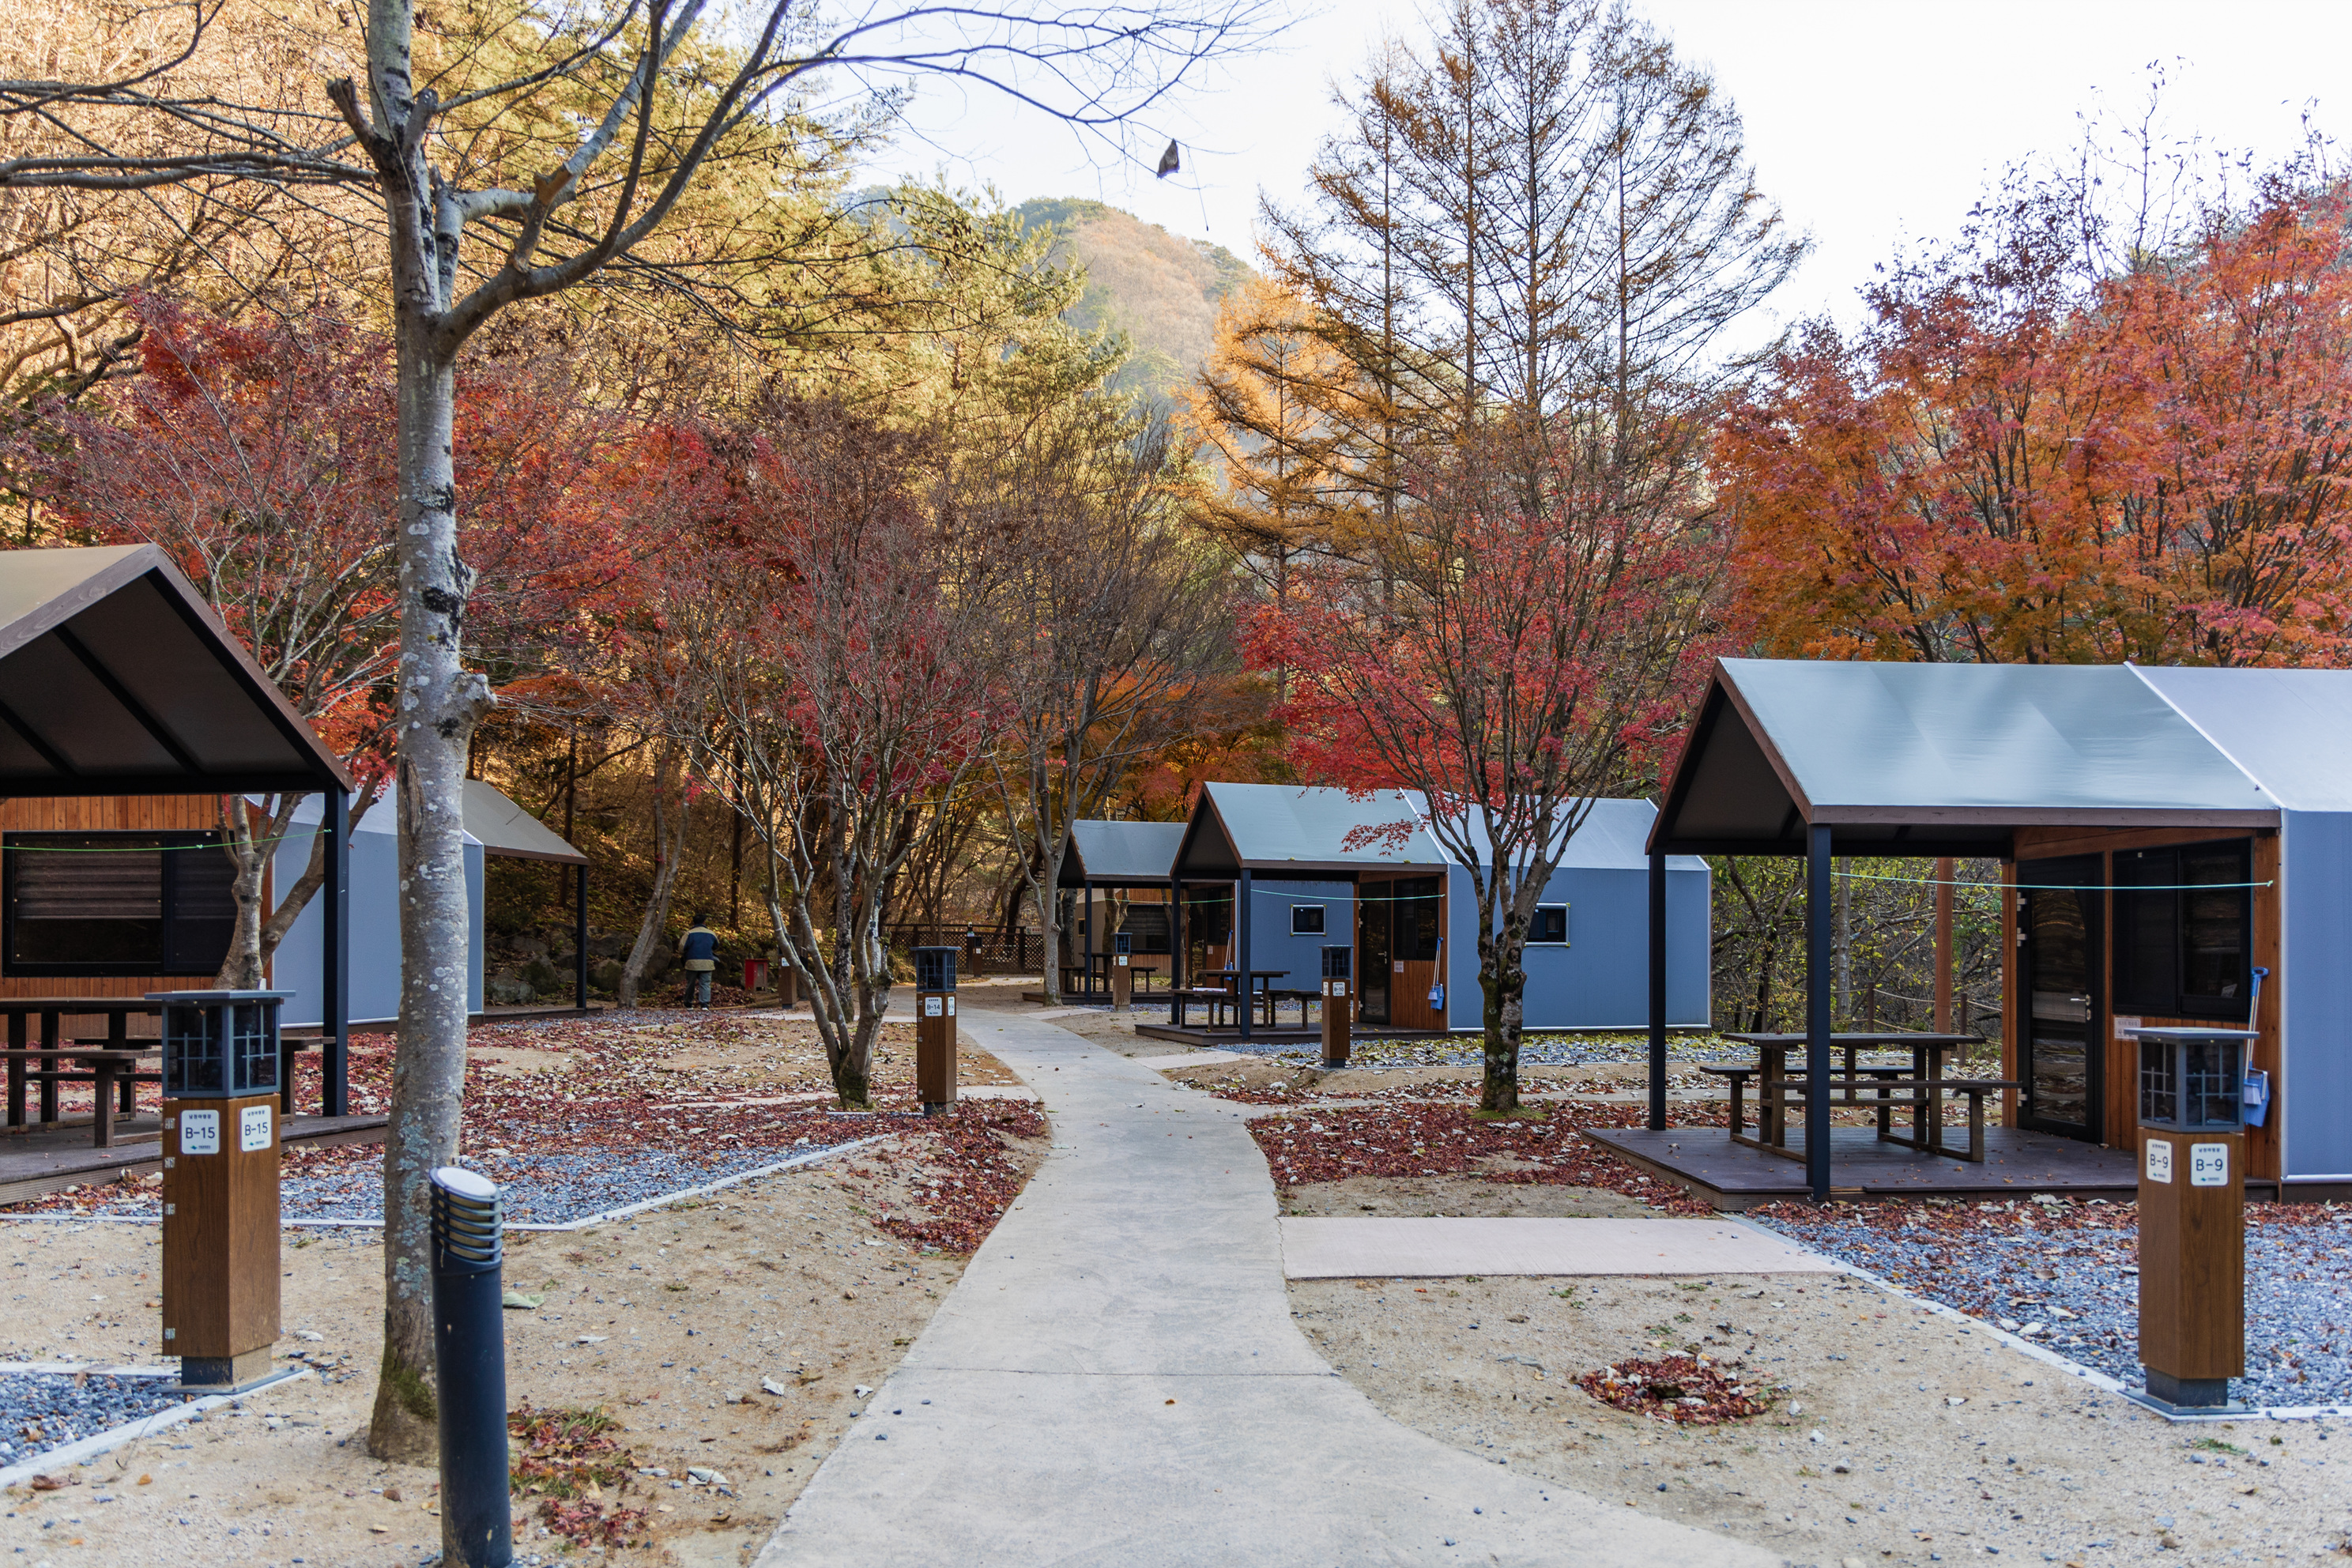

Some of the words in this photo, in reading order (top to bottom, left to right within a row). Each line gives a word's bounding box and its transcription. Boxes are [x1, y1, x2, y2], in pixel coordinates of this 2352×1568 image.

[186, 1126, 216, 1139] B-15
[245, 1121, 268, 1136] B-15
[2150, 1153, 2169, 1169] B-9
[2196, 1159, 2223, 1171] B-9
